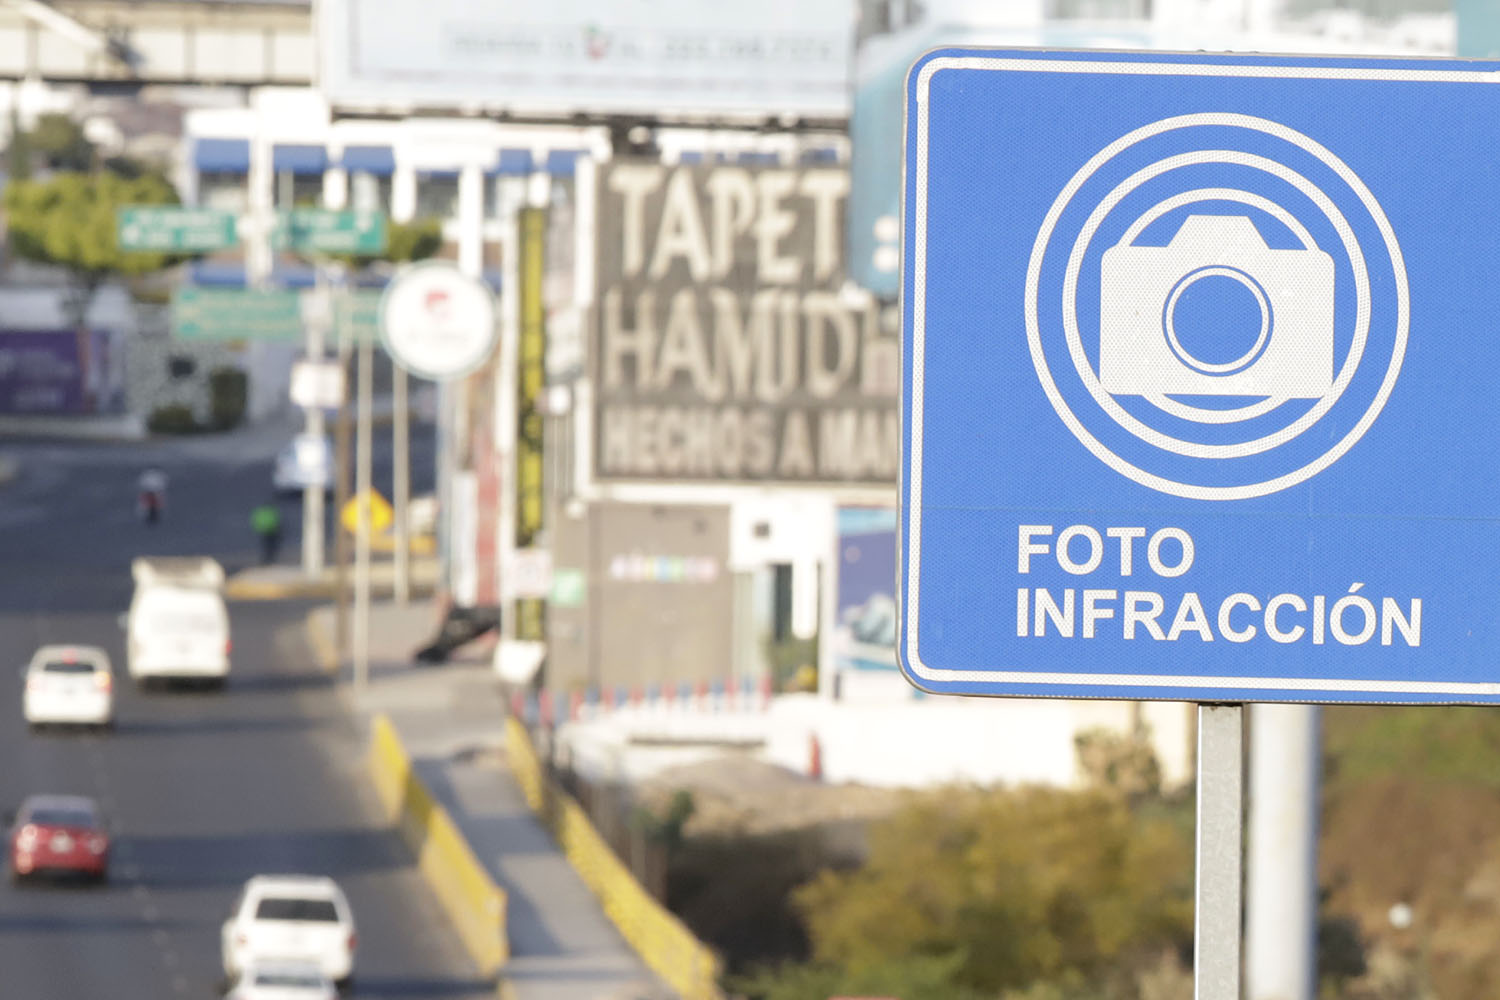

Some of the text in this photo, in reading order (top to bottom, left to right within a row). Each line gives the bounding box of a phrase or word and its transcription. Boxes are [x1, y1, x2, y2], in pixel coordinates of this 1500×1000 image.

[609, 163, 849, 284] TAPET
[605, 403, 776, 478] HECHOS
[777, 405, 818, 478] A
[1017, 524, 1196, 578] FOTO
[1016, 582, 1423, 647] INFRACCIÓN
